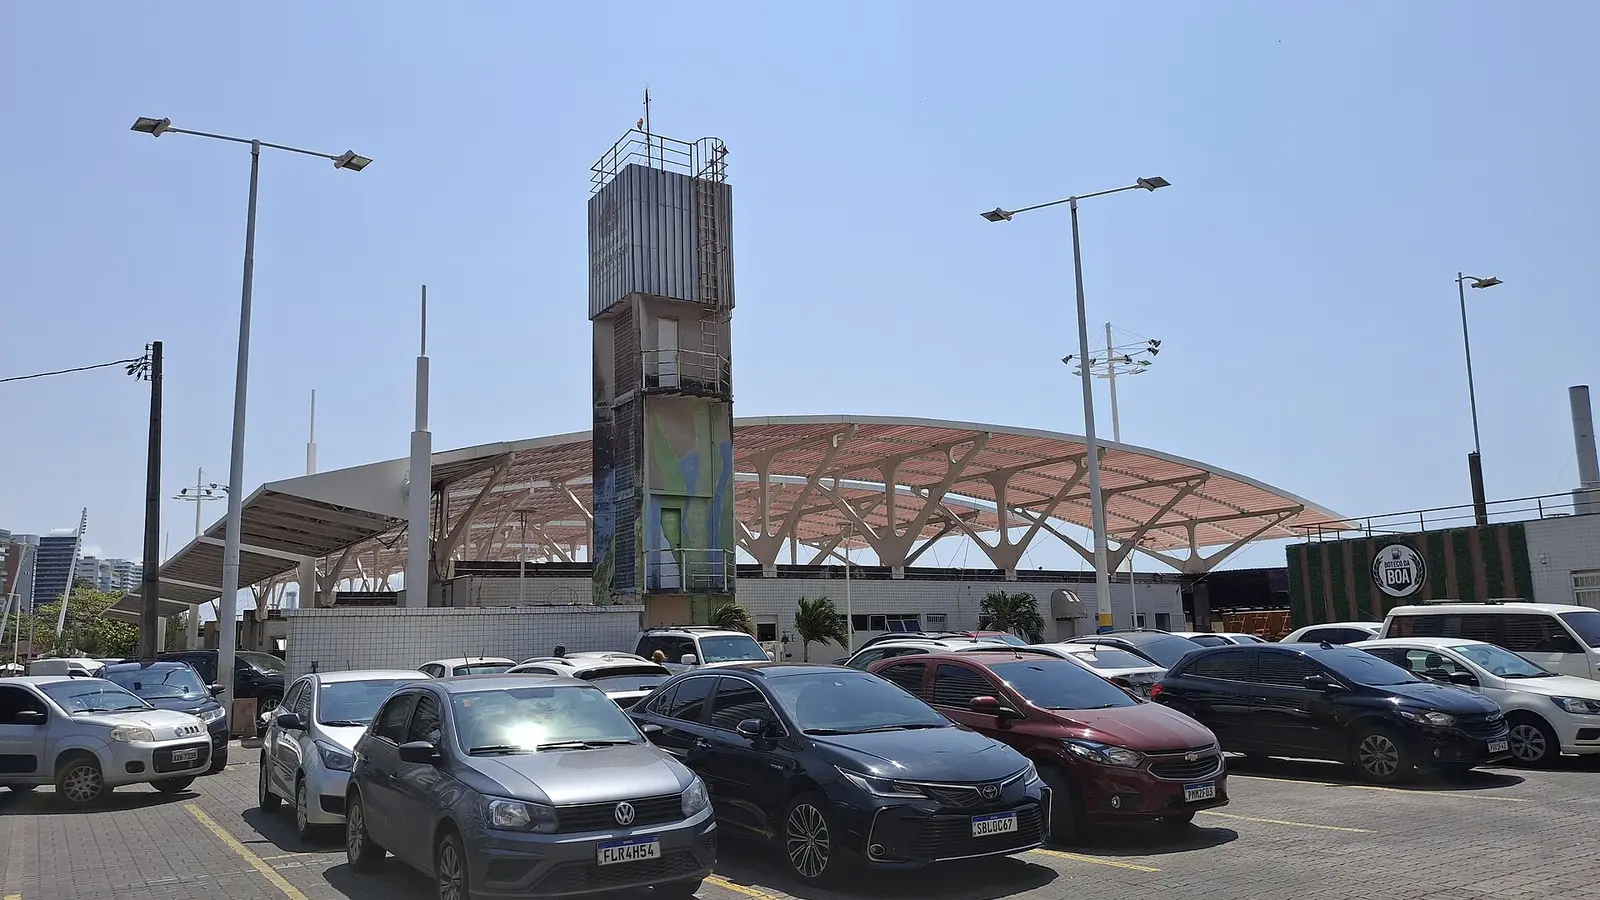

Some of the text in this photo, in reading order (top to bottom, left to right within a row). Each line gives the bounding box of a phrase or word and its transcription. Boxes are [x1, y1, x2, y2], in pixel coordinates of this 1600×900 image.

[1384, 560, 1403, 568] BOTECO
[1387, 569, 1410, 585] BOA
[603, 843, 654, 863] FLR4H54
